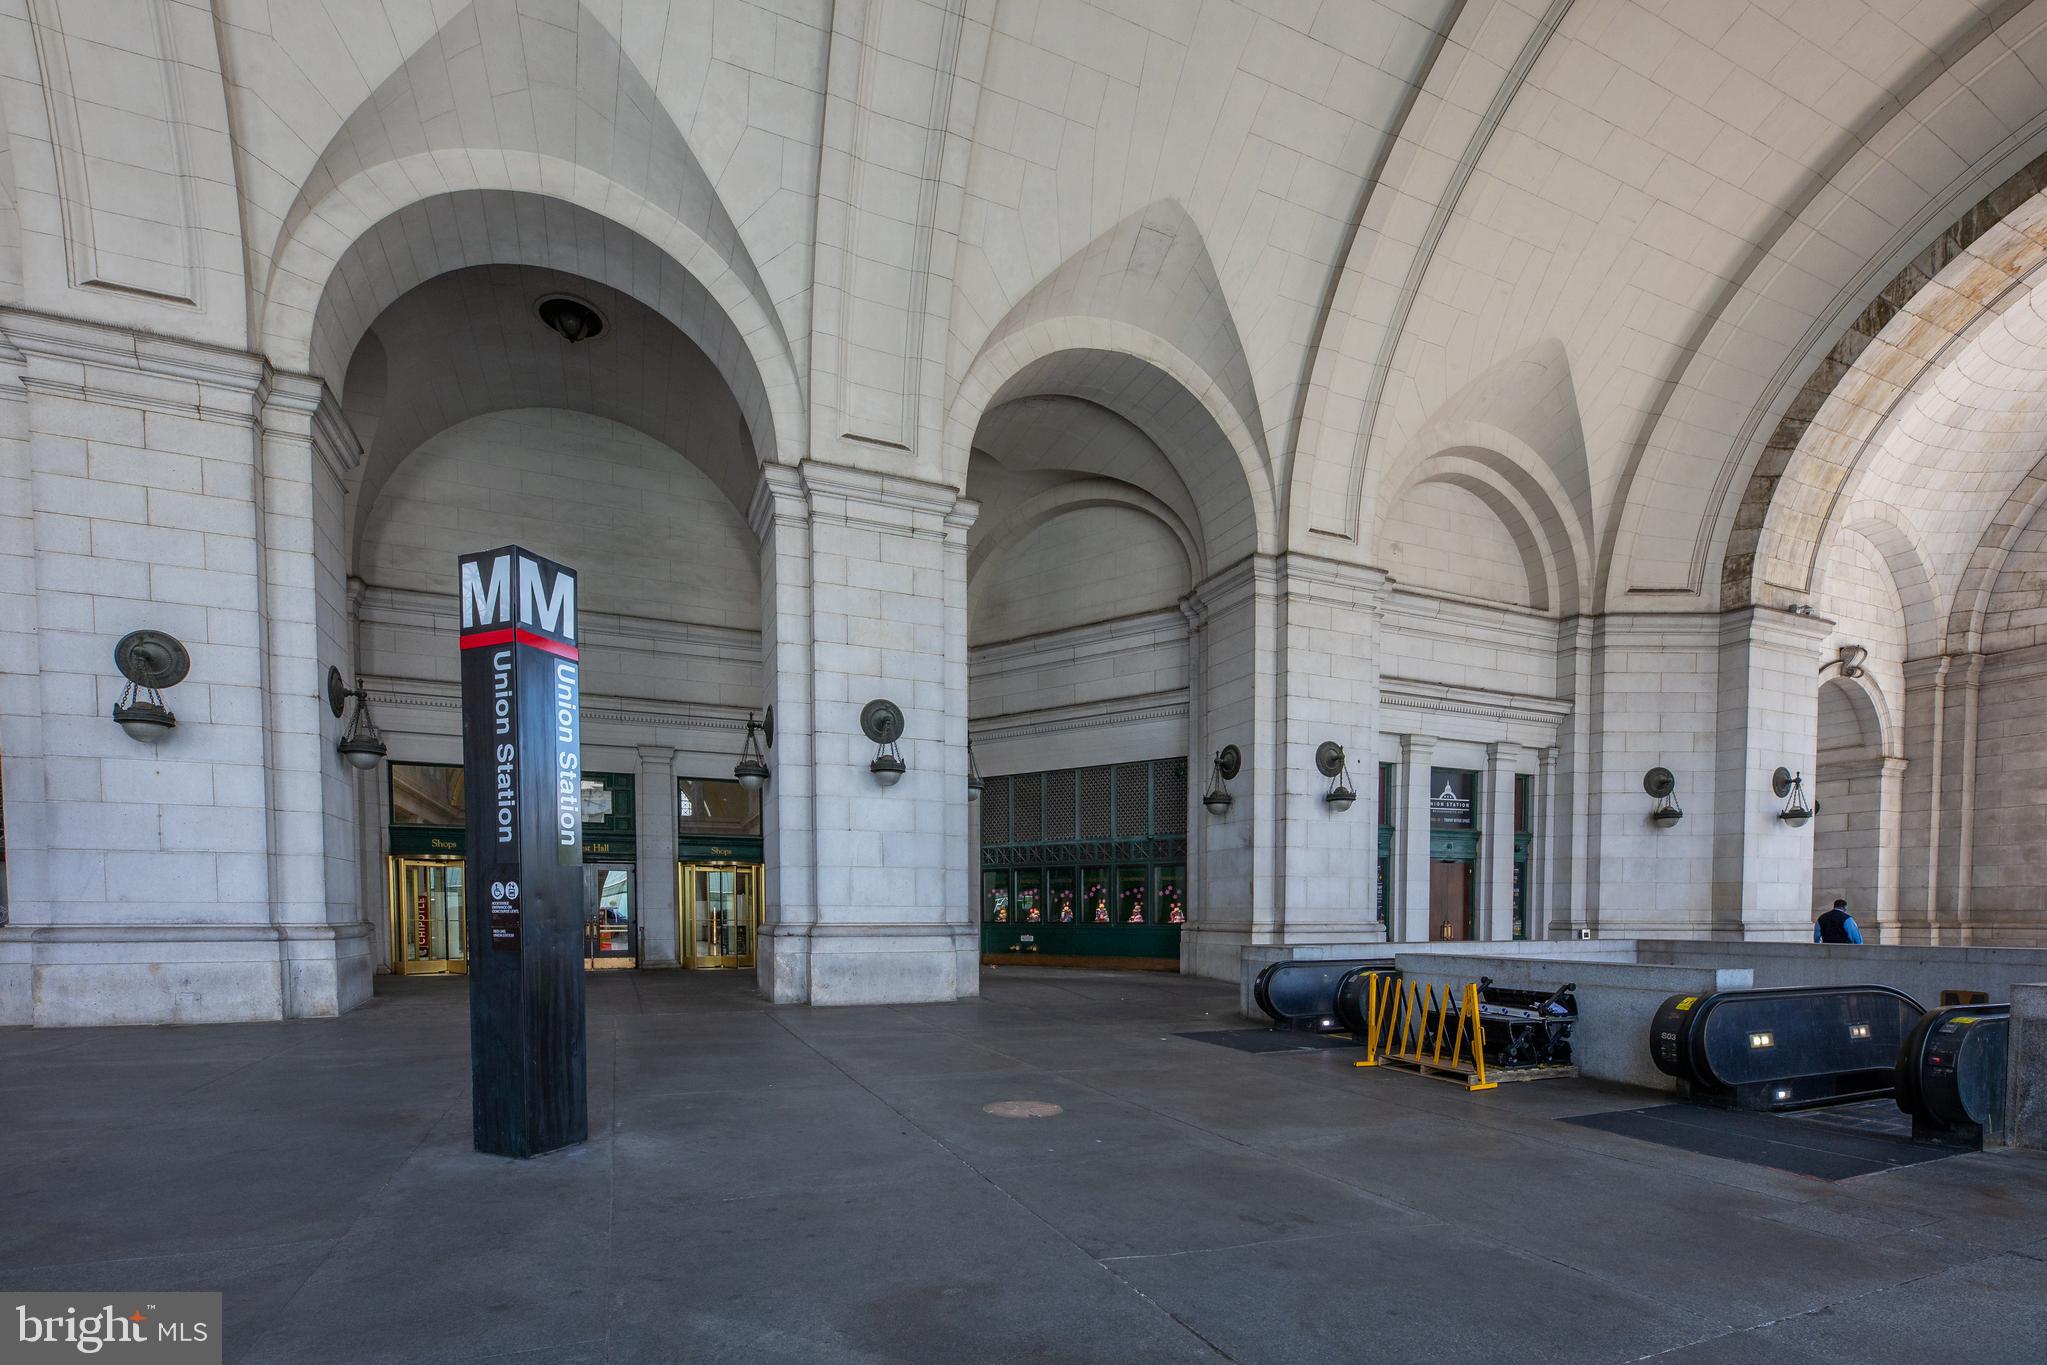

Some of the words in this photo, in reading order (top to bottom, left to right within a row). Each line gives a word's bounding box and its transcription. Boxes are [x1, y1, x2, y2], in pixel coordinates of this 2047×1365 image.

[461, 554, 511, 628] M
[518, 556, 575, 640] M
[493, 650, 512, 734] Union
[556, 663, 576, 743] Union
[496, 743, 516, 844] Station
[559, 751, 579, 846] Station
[431, 838, 457, 850] Shops
[593, 843, 609, 852] Hall
[711, 846, 732, 856] Shops
[418, 896, 426, 945] CHIPOTLE
